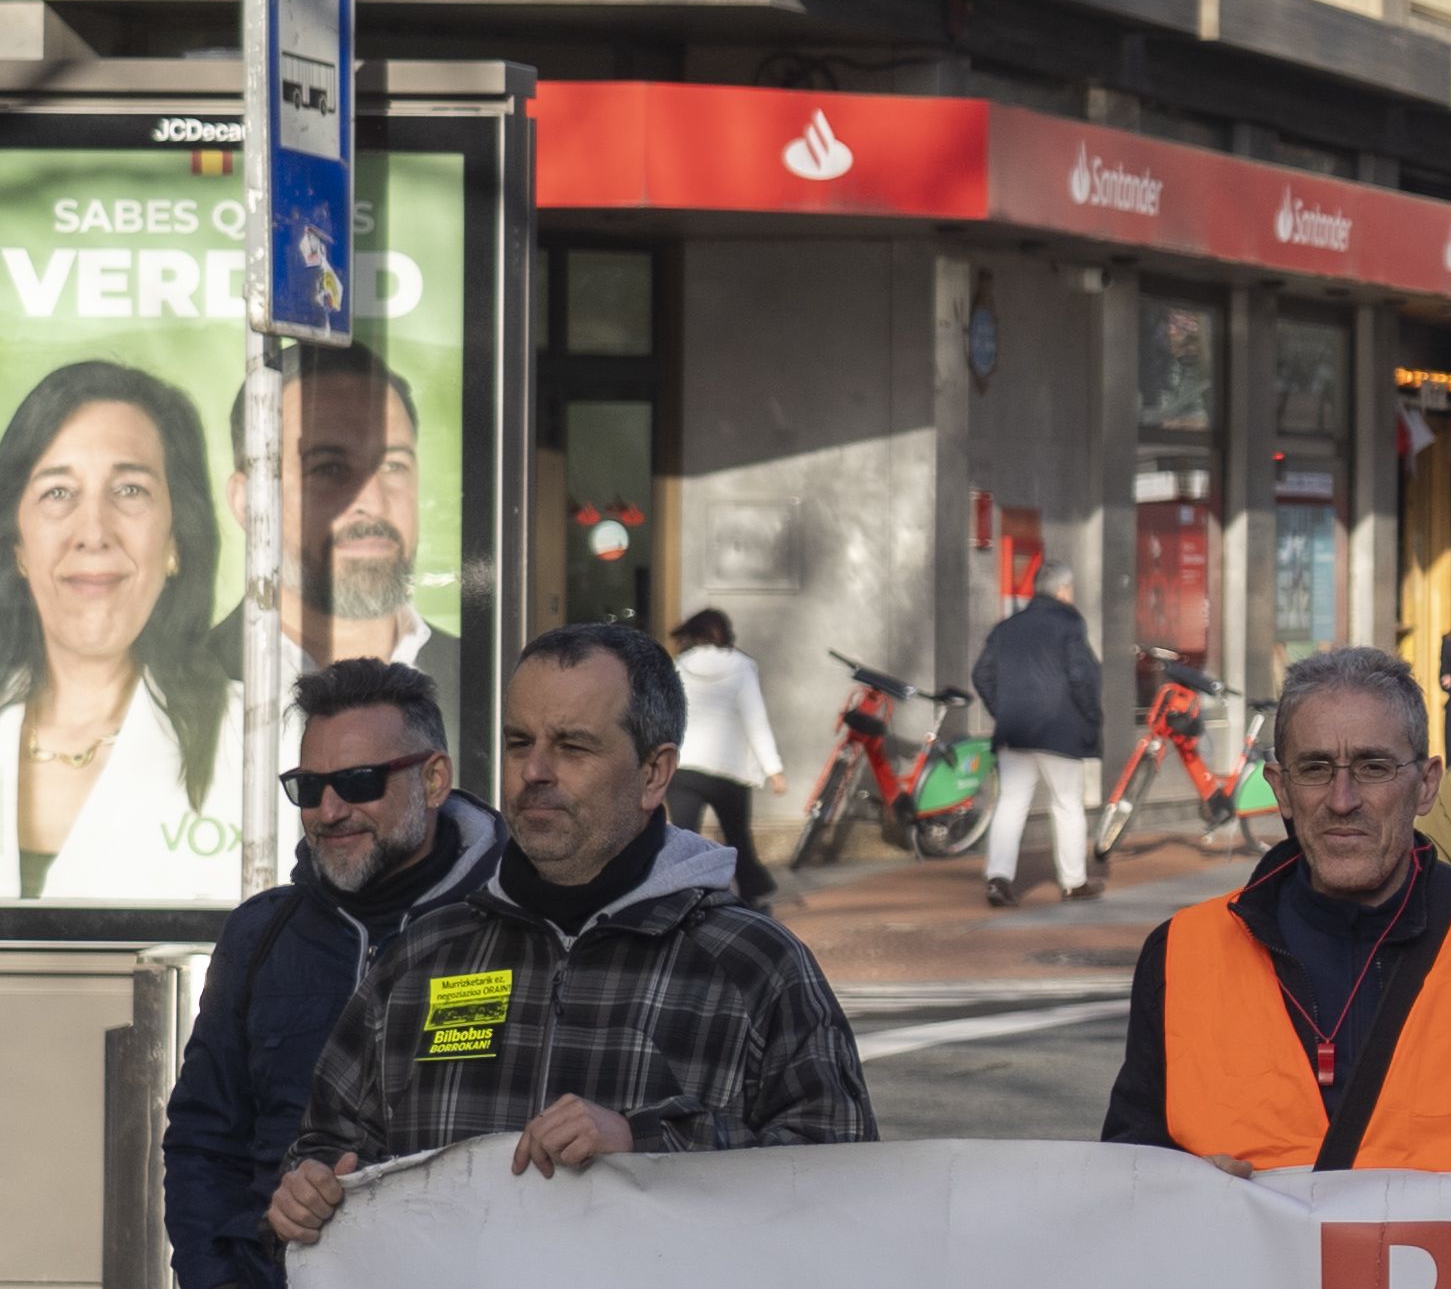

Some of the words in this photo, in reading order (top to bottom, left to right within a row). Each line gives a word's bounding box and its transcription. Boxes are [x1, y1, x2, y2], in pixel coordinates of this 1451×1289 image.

[151, 118, 246, 143] JCDeca
[1090, 156, 1163, 216] Santander
[53, 197, 199, 234] SABES
[1291, 197, 1352, 252] Santander
[2, 248, 423, 318] VERDD
[429, 1040, 491, 1054] BORROKAN!
[433, 1027, 493, 1044] Bilbobus
